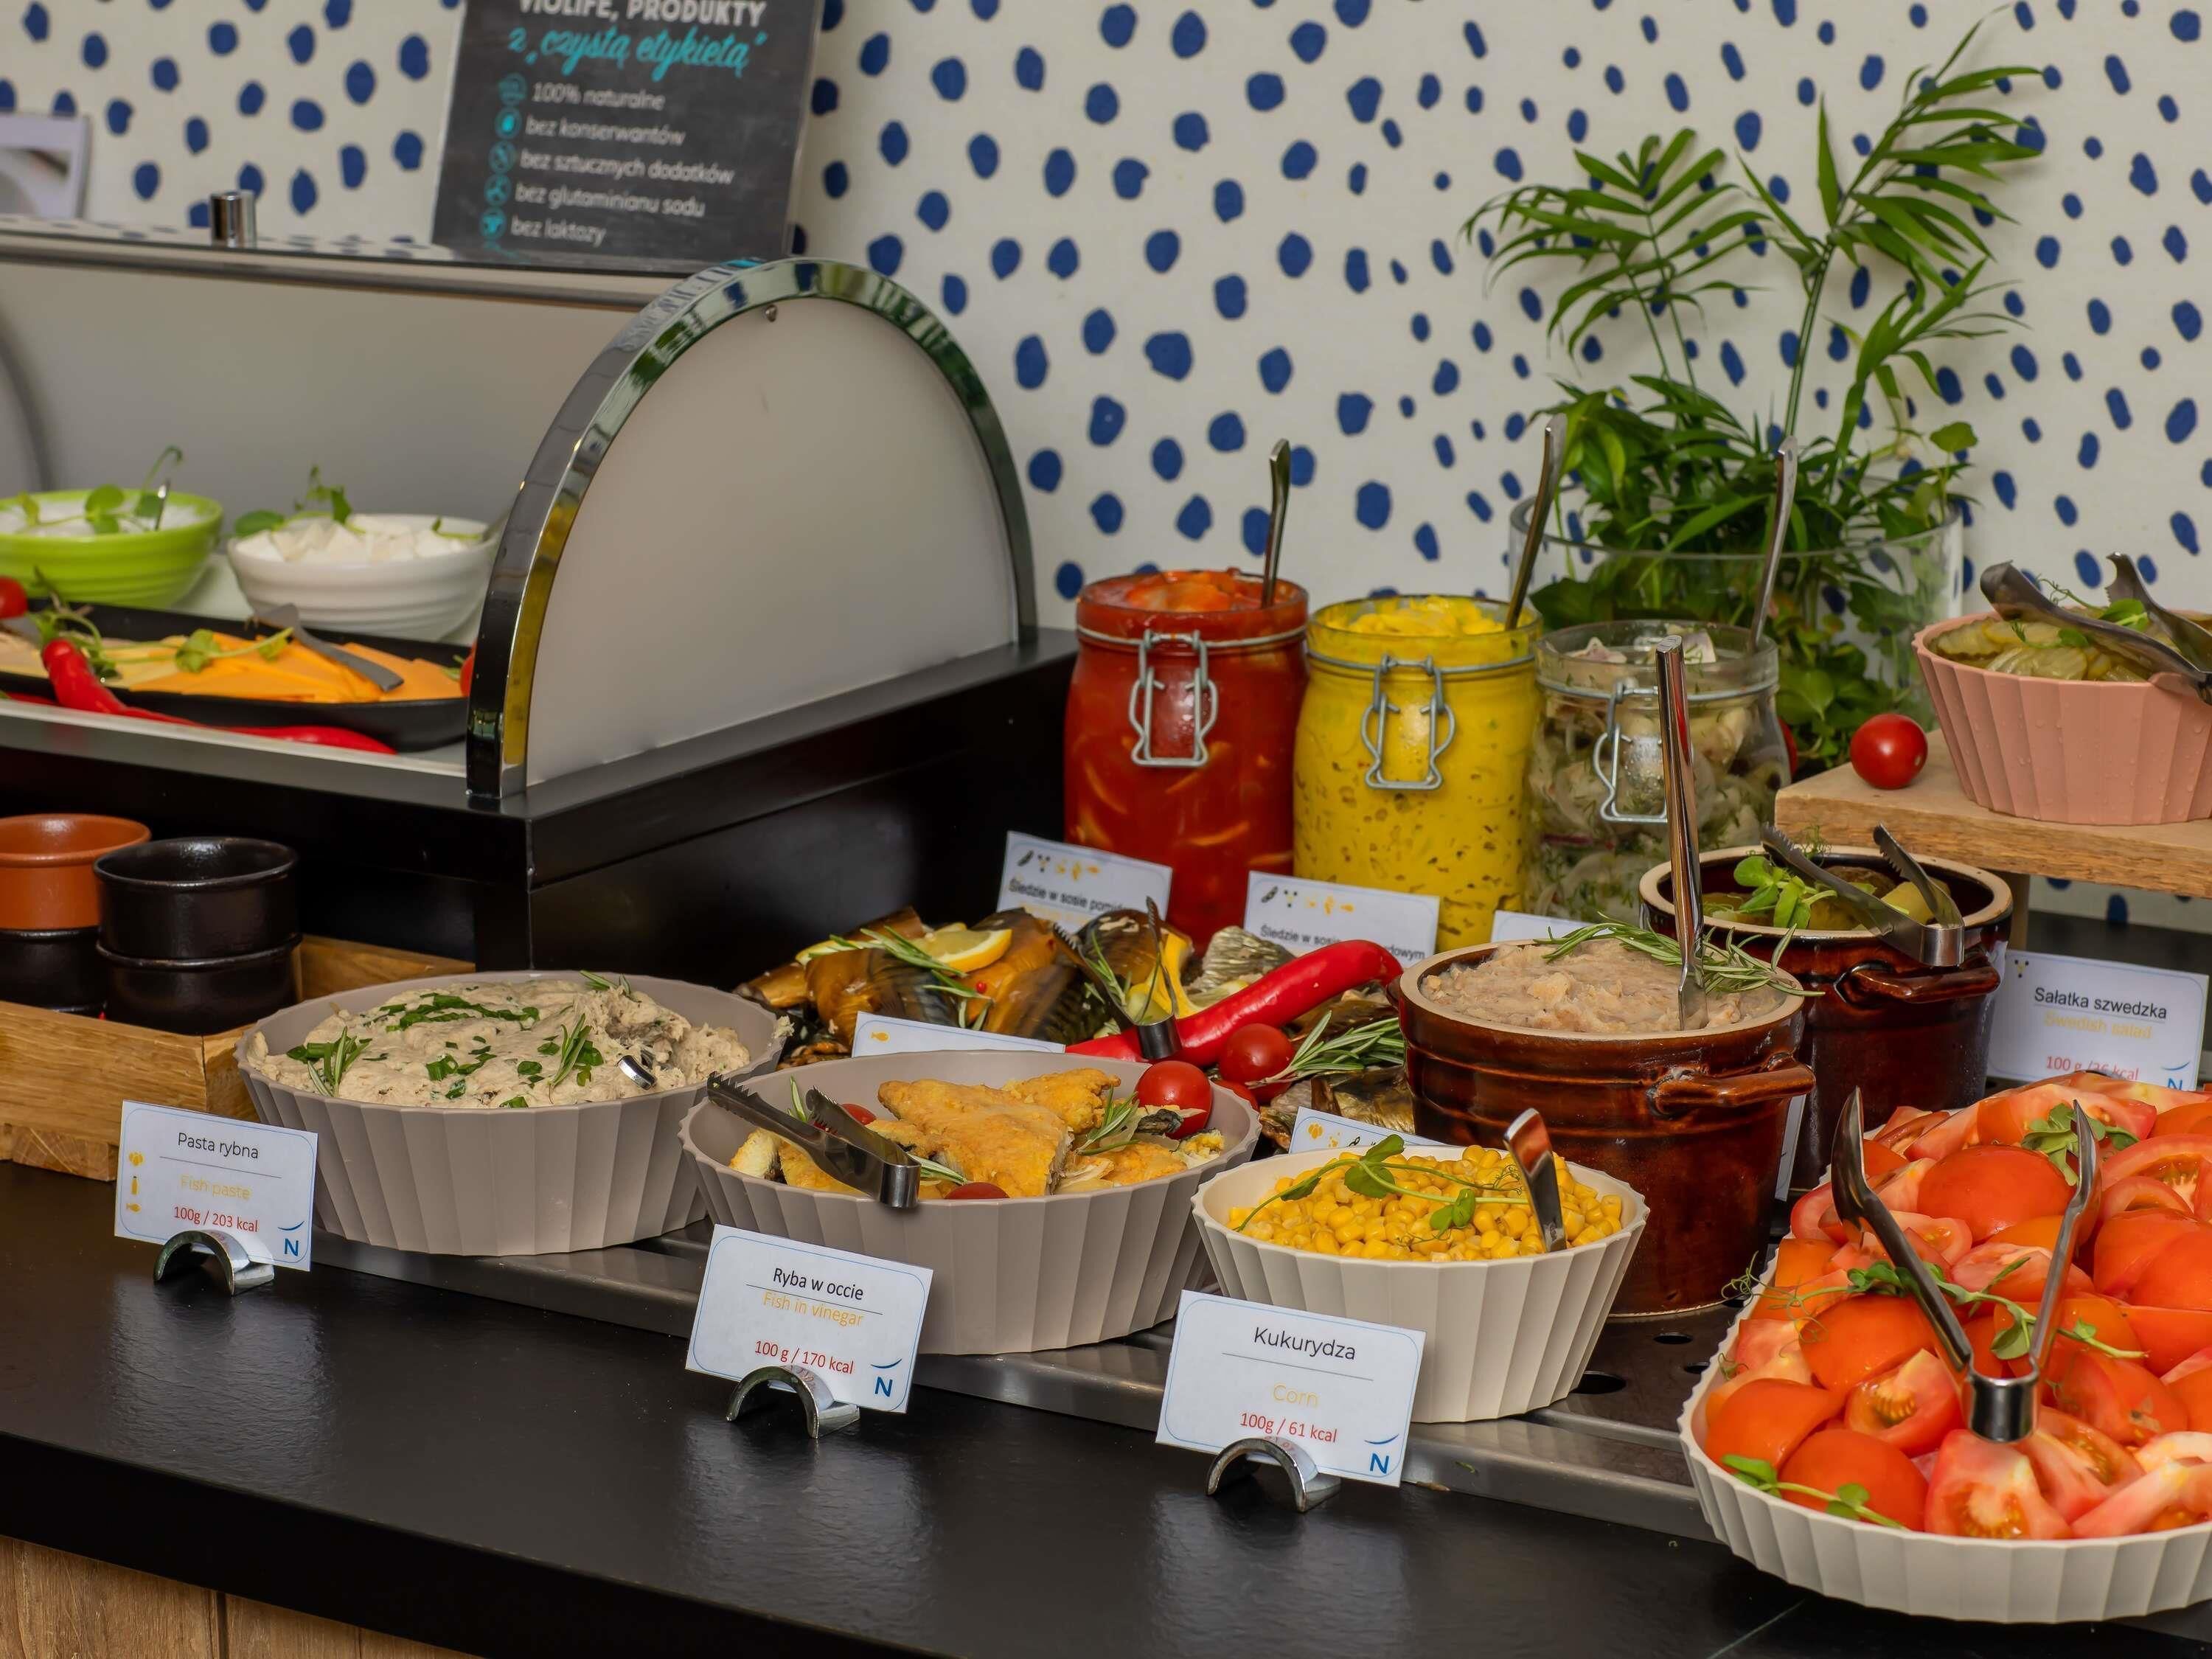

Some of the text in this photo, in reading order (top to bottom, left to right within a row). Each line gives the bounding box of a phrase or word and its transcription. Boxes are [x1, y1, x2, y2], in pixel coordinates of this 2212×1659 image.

[626, 0, 767, 27] PRODUKTY
[532, 81, 666, 111] 100% naturalne
[525, 113, 686, 146] bez konserwantów
[520, 148, 734, 184] bez sztucznych dodatków
[515, 183, 706, 218] bez glutaminianu sodu
[510, 215, 606, 248] bez laktozy
[1049, 892, 1057, 900] w
[1060, 893, 1088, 908] sosie
[1260, 925, 1298, 942] Śledzie
[1301, 935, 1311, 943] w
[2034, 987, 2167, 1019] Sałatka szwedzka
[2047, 1056, 2070, 1071] 100
[2113, 1065, 2139, 1081] kcal
[178, 1133, 259, 1159] Pasta rybna
[180, 1175, 251, 1200] Fish paste
[174, 1206, 258, 1233] 100g / 203 kcal
[284, 1239, 299, 1256] N
[773, 1267, 863, 1301] Ryba w occie
[762, 1291, 863, 1327] Fish in vinegar
[755, 1340, 855, 1374] 100 g / 170 kcal
[1253, 1326, 1356, 1360] Kukurydza
[874, 1376, 893, 1397] N
[1273, 1382, 1320, 1408] Corn
[1239, 1412, 1338, 1443] 100g / 61 kcal
[1369, 1453, 1389, 1474] N
